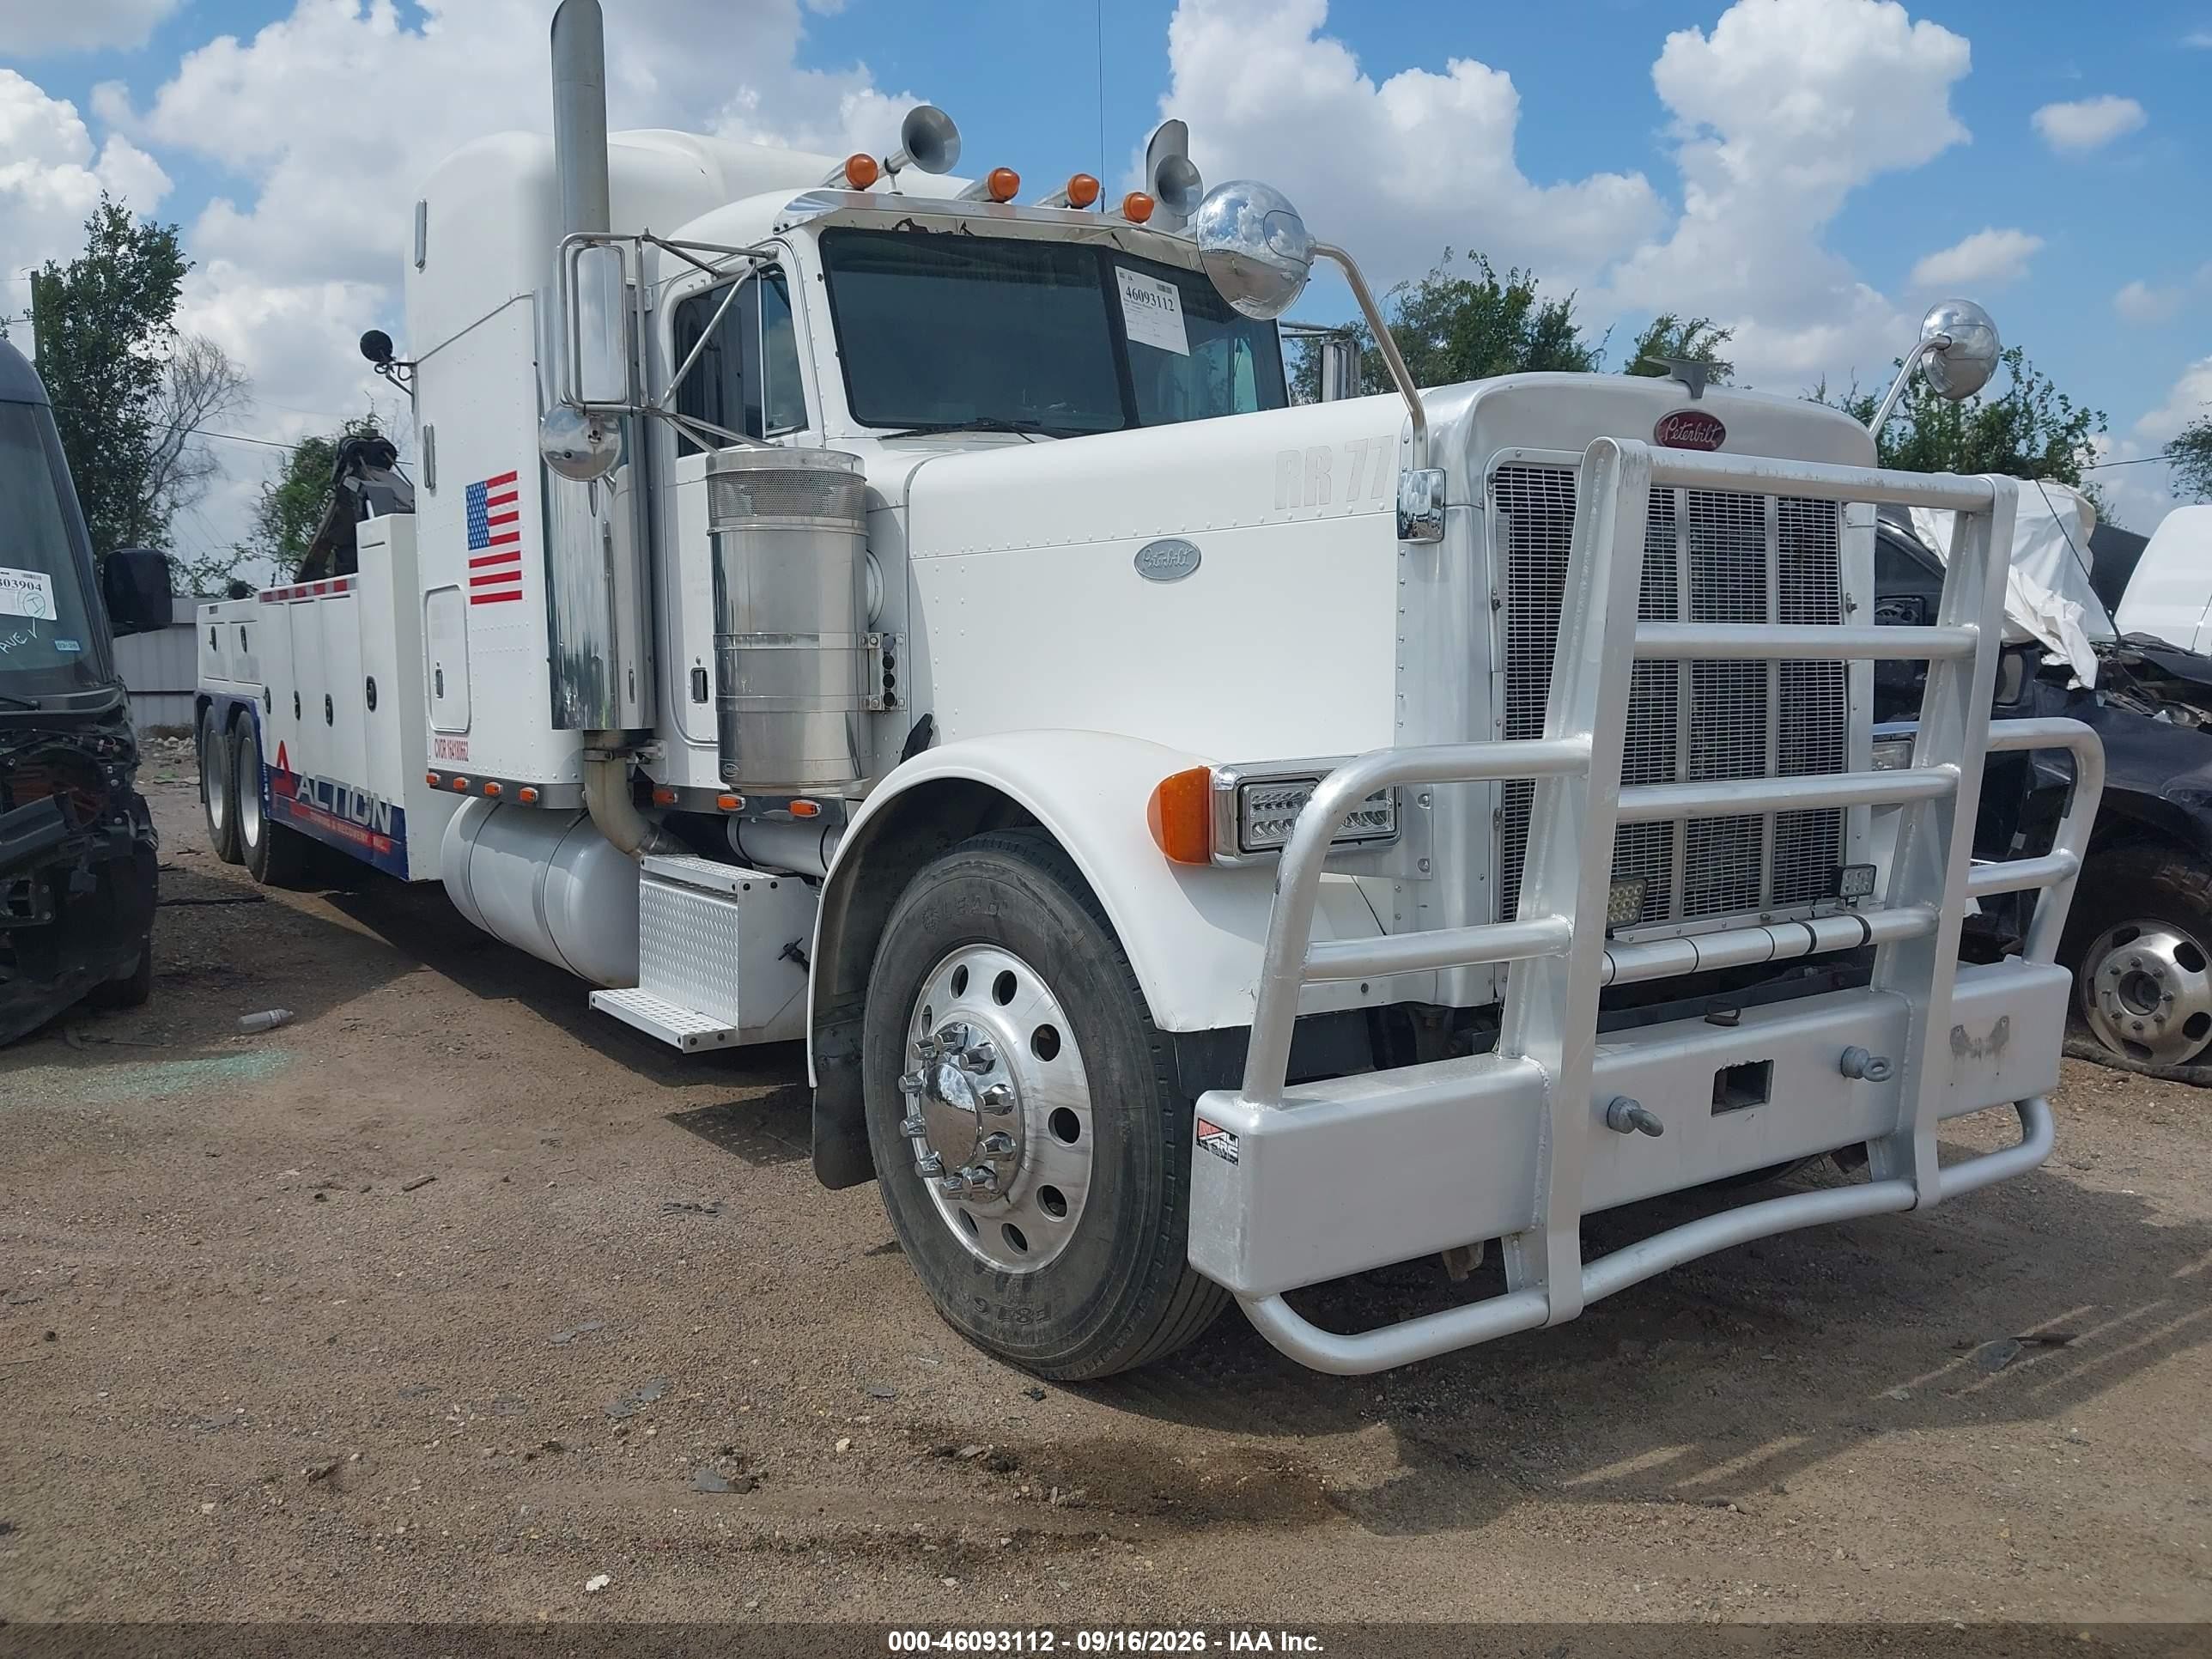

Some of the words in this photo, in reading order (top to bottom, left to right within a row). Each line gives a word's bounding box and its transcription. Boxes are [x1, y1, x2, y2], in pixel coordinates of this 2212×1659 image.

[1126, 285, 1174, 312] 46093112
[1662, 416, 1723, 445] Peterbilt
[1345, 434, 1395, 502] 77
[295, 771, 392, 835] ACTION
